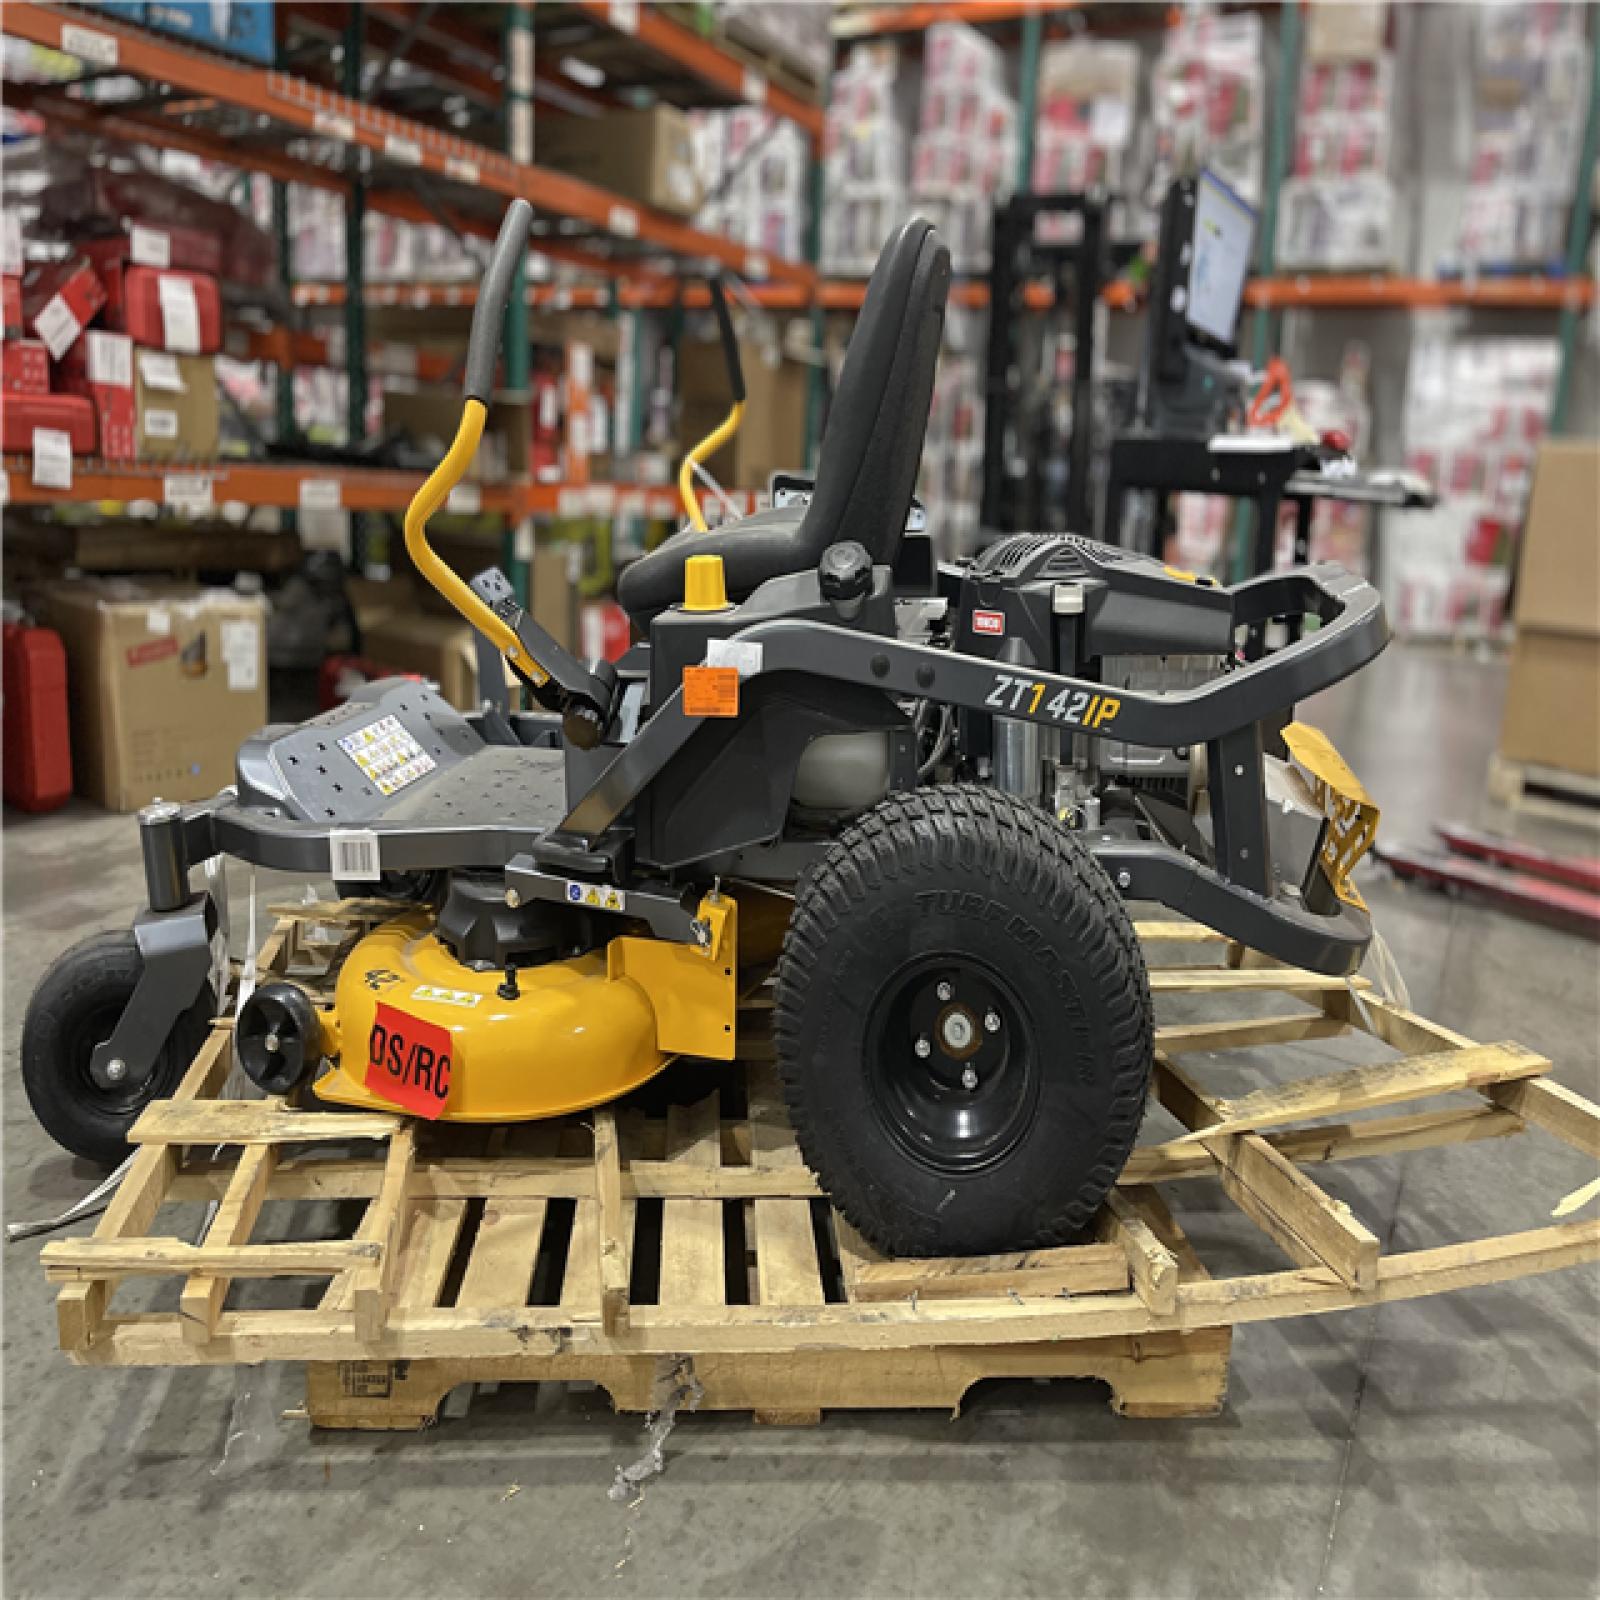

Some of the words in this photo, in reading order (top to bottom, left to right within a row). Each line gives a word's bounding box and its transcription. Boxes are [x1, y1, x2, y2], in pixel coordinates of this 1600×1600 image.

[984, 674, 1046, 715] ZT1
[913, 888, 1010, 921] TURF
[1003, 912, 1097, 1086] MASTER
